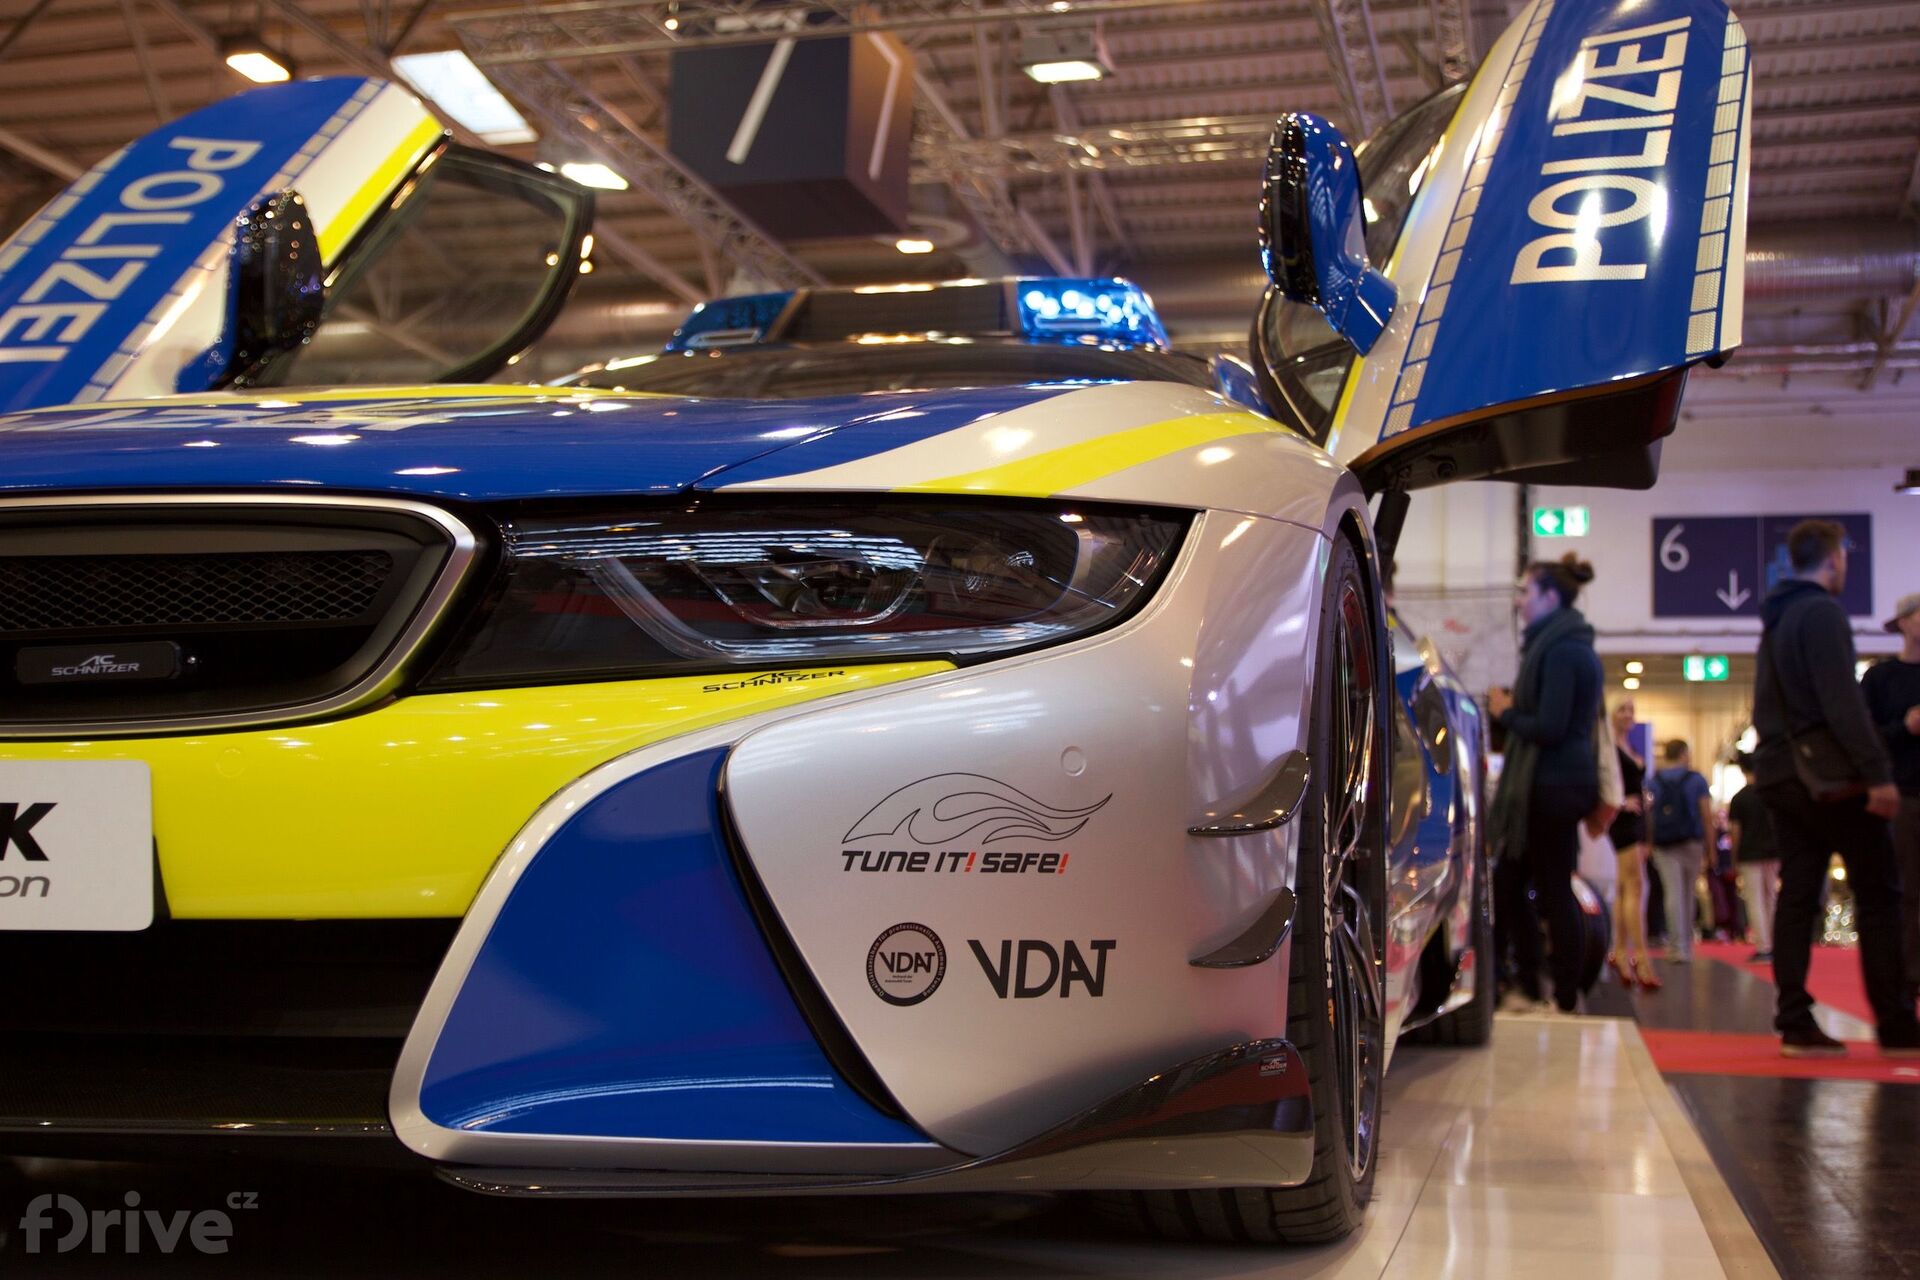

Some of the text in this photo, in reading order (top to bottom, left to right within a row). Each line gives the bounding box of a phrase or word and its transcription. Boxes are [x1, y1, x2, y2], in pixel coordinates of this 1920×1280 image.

[1510, 16, 1692, 285] POLIZEI
[1660, 524, 1690, 572] 6
[51, 662, 140, 676] SCHNITZER
[79, 655, 116, 666] AC
[703, 670, 845, 694] SCHNITZER
[878, 951, 936, 974] VDAT
[966, 939, 1117, 999] VDAT
